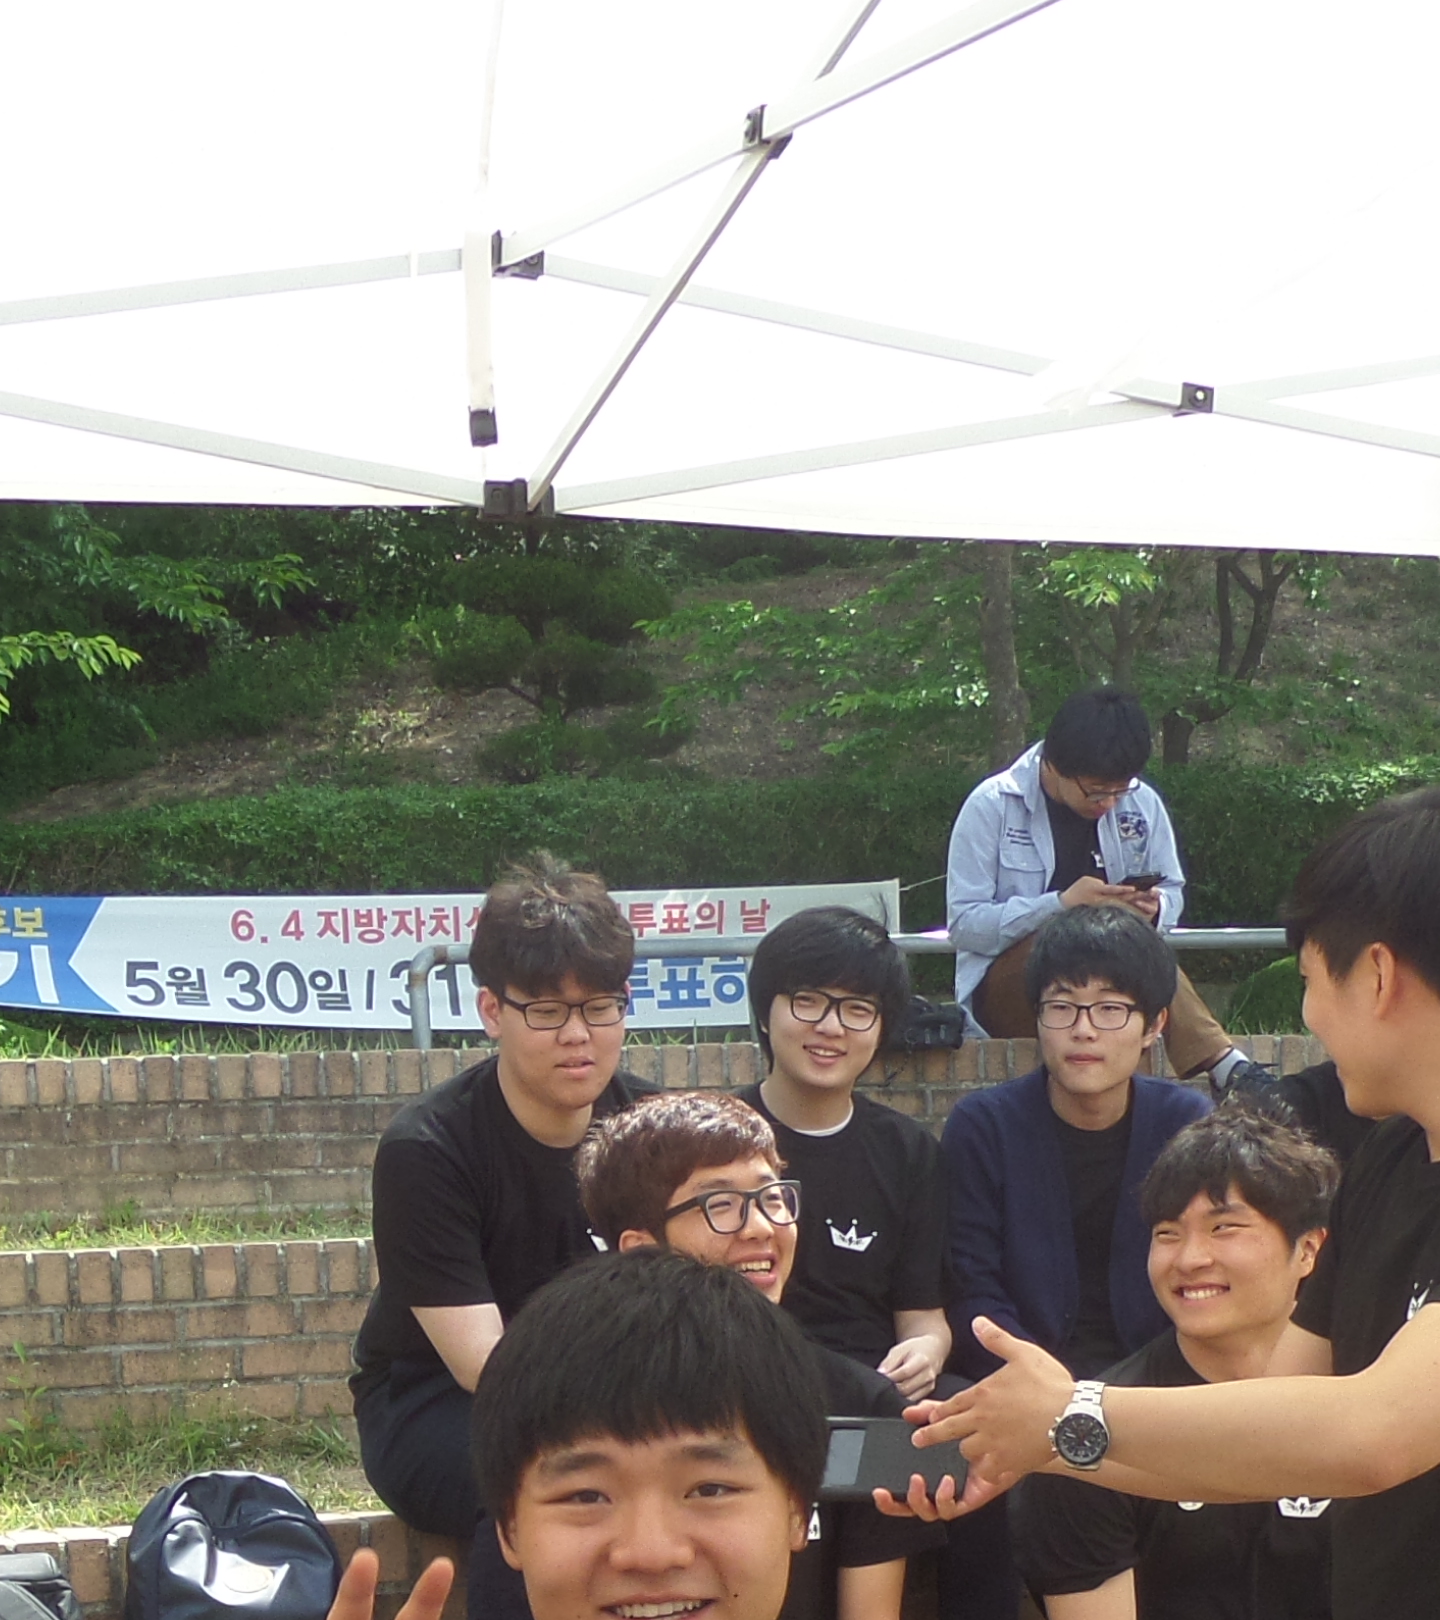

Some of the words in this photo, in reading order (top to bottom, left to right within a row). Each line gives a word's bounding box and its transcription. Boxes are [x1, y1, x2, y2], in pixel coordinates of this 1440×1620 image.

[617, 899, 725, 938] 투표의
[740, 898, 772, 934] 날
[125, 960, 211, 1007] 5월
[223, 960, 352, 1014] 30일
